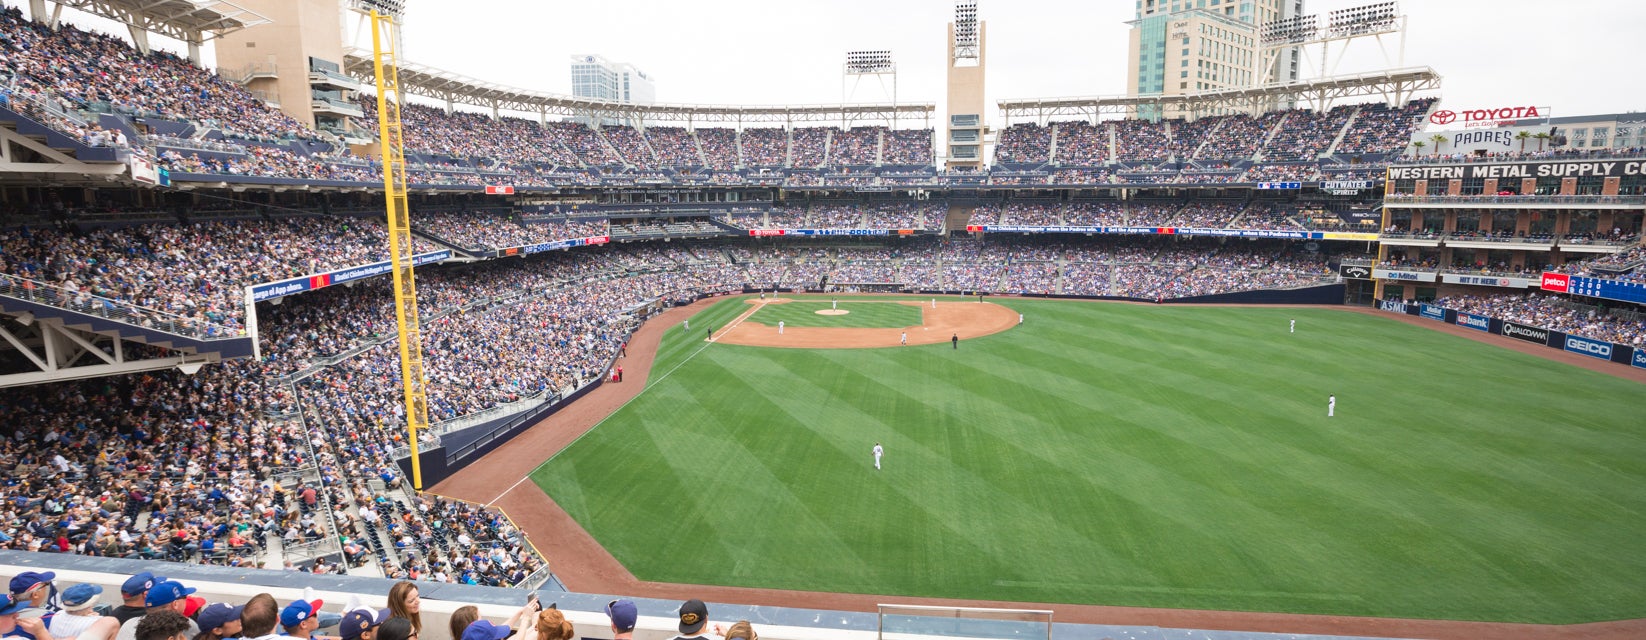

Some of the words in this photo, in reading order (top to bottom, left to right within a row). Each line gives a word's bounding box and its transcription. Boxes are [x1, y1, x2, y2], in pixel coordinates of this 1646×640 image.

[1462, 105, 1539, 122] TOYOTA
[1453, 130, 1513, 148] PADRES
[1390, 166, 1464, 180] WESTERN
[1472, 164, 1531, 178] METAL
[1537, 162, 1617, 177] SUPPLY
[1325, 181, 1367, 189] CUTWATER
[1398, 272, 1418, 280] Mitel
[1544, 277, 1566, 288] petco
[1380, 301, 1407, 313] ASML
[1503, 323, 1546, 341] QUALCOMM
[1567, 338, 1610, 356] GEICO
